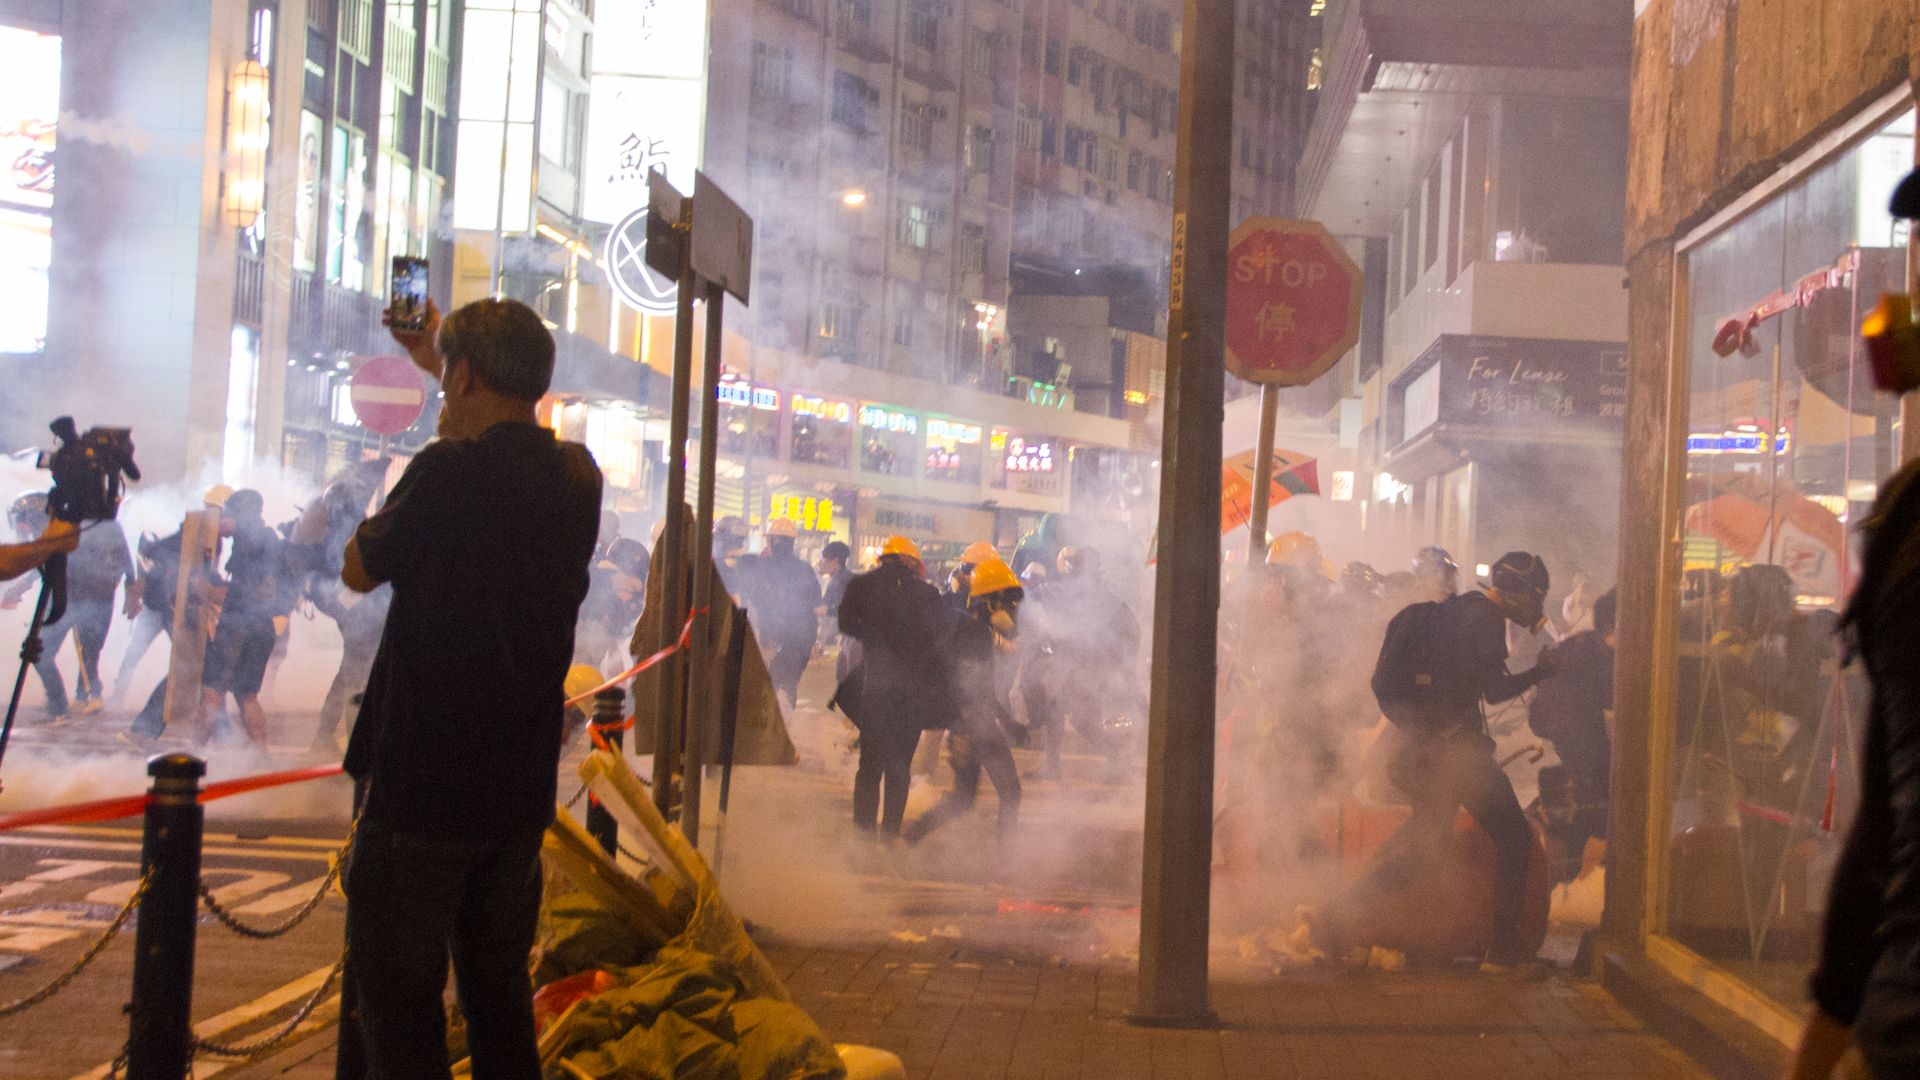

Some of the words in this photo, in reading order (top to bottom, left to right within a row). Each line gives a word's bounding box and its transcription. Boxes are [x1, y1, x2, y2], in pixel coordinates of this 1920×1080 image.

[1234, 255, 1328, 288] STOP
[1254, 301, 1295, 342] 停
[1468, 356, 1502, 381] For
[1508, 360, 1569, 385] Lease
